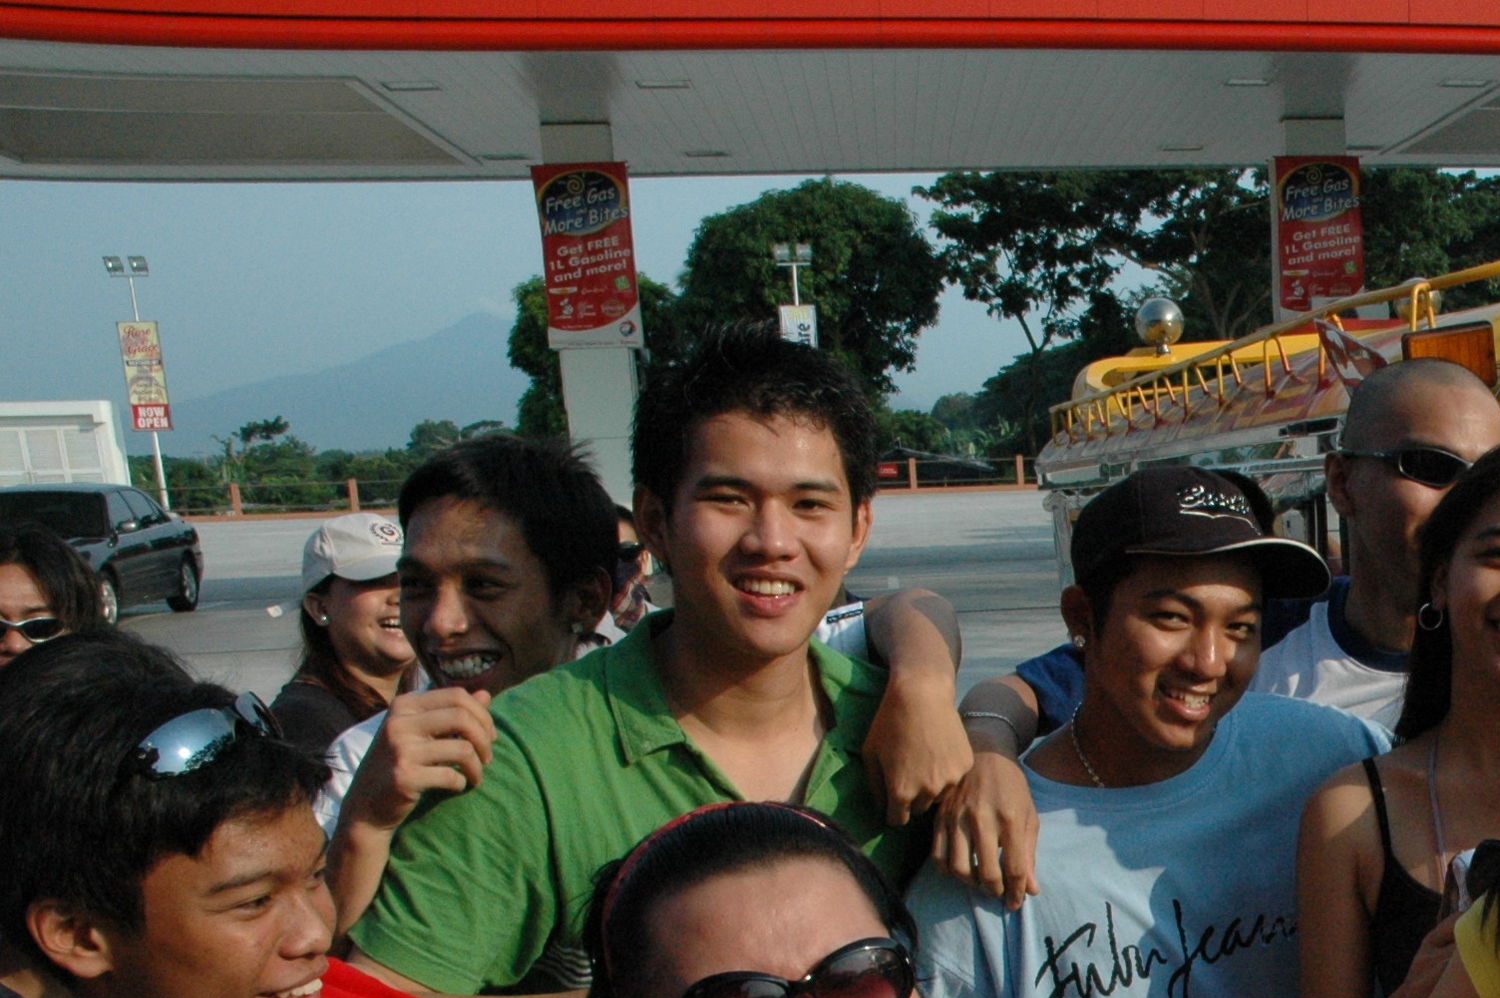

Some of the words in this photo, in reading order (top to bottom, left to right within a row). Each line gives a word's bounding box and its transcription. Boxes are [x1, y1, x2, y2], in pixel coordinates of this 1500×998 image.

[1286, 185, 1319, 201] Free
[1323, 179, 1349, 193] Gas
[545, 195, 582, 215] Free
[586, 187, 615, 205] Gas
[1282, 205, 1319, 221] More
[1324, 196, 1360, 213] Bites
[544, 218, 583, 236] More
[589, 206, 629, 226] Bites
[1293, 230, 1316, 242] Get
[1321, 224, 1350, 239] FREE
[1303, 235, 1360, 251] Gasoline
[557, 245, 583, 257] Get
[587, 235, 620, 251] FREE
[1288, 252, 1314, 265] and
[1318, 245, 1356, 260] more!
[569, 248, 631, 267] Gasoline
[554, 268, 582, 283] and
[586, 260, 627, 277] more!
[138, 405, 165, 418] NOW
[137, 417, 169, 429] OPEN
